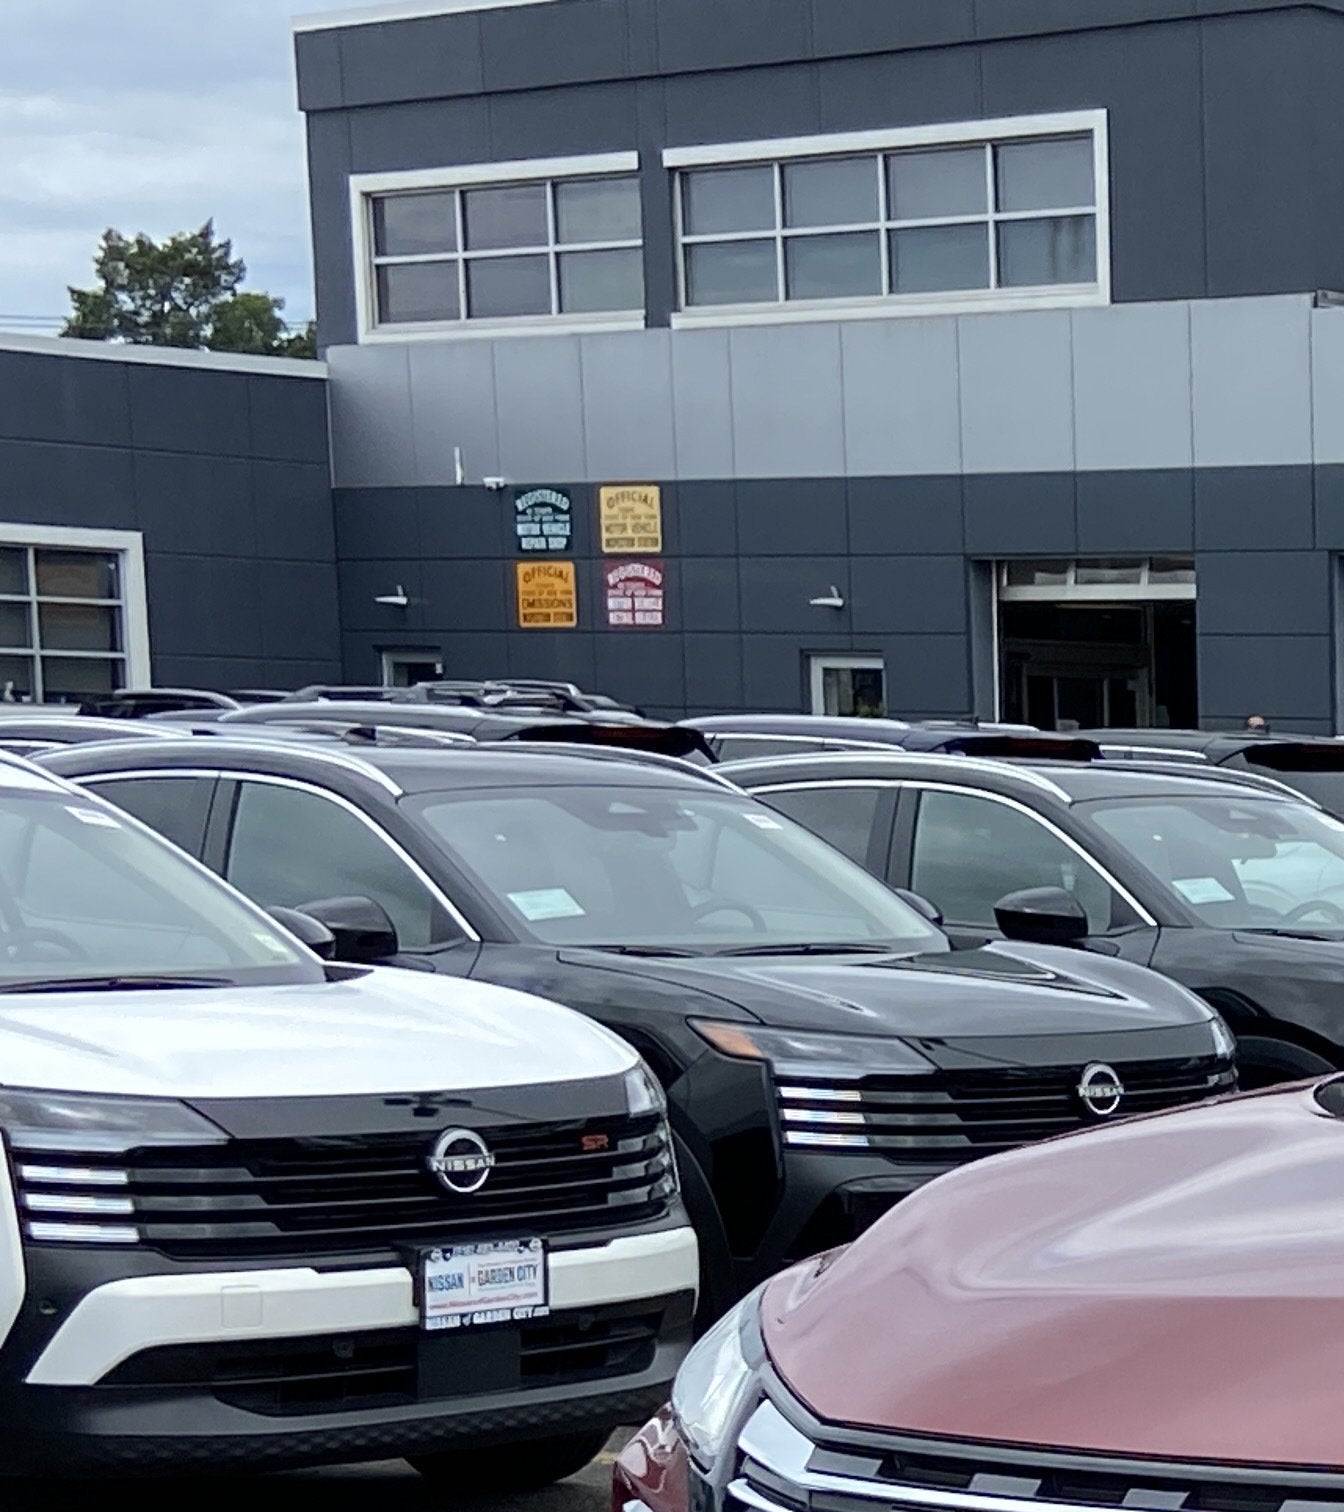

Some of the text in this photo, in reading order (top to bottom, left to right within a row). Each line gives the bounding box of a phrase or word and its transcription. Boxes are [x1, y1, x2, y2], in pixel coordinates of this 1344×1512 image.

[606, 490, 655, 510] OFFICIAL
[523, 565, 570, 584] OFFICIAL
[582, 1134, 608, 1150] SR
[432, 1156, 495, 1172] NISSAN
